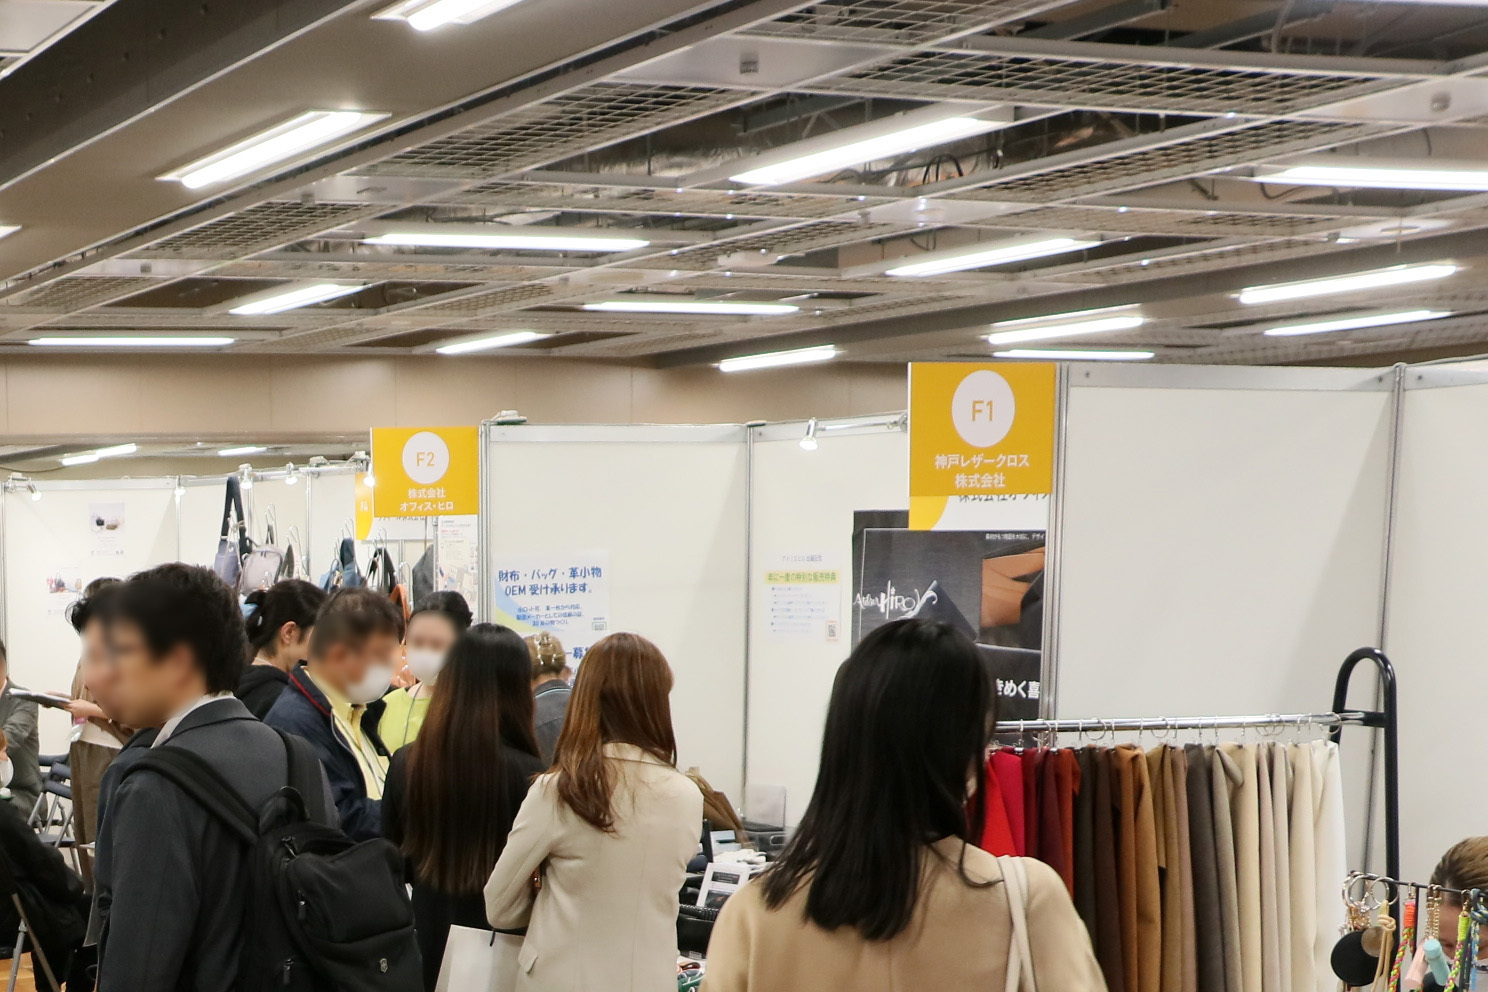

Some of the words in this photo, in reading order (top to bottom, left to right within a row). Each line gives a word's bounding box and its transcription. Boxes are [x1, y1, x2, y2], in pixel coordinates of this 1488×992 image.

[971, 400, 994, 421] F1
[416, 451, 436, 467] F2
[935, 453, 1030, 470] 神戸レザークロス
[955, 473, 1006, 488] 株式会社
[408, 487, 446, 498] 株式会社
[400, 501, 454, 511] オフィス・ヒロ
[498, 566, 602, 582] 財布・バッグ・革小物
[505, 585, 526, 596] OEM
[529, 582, 592, 596] 受け承ります。
